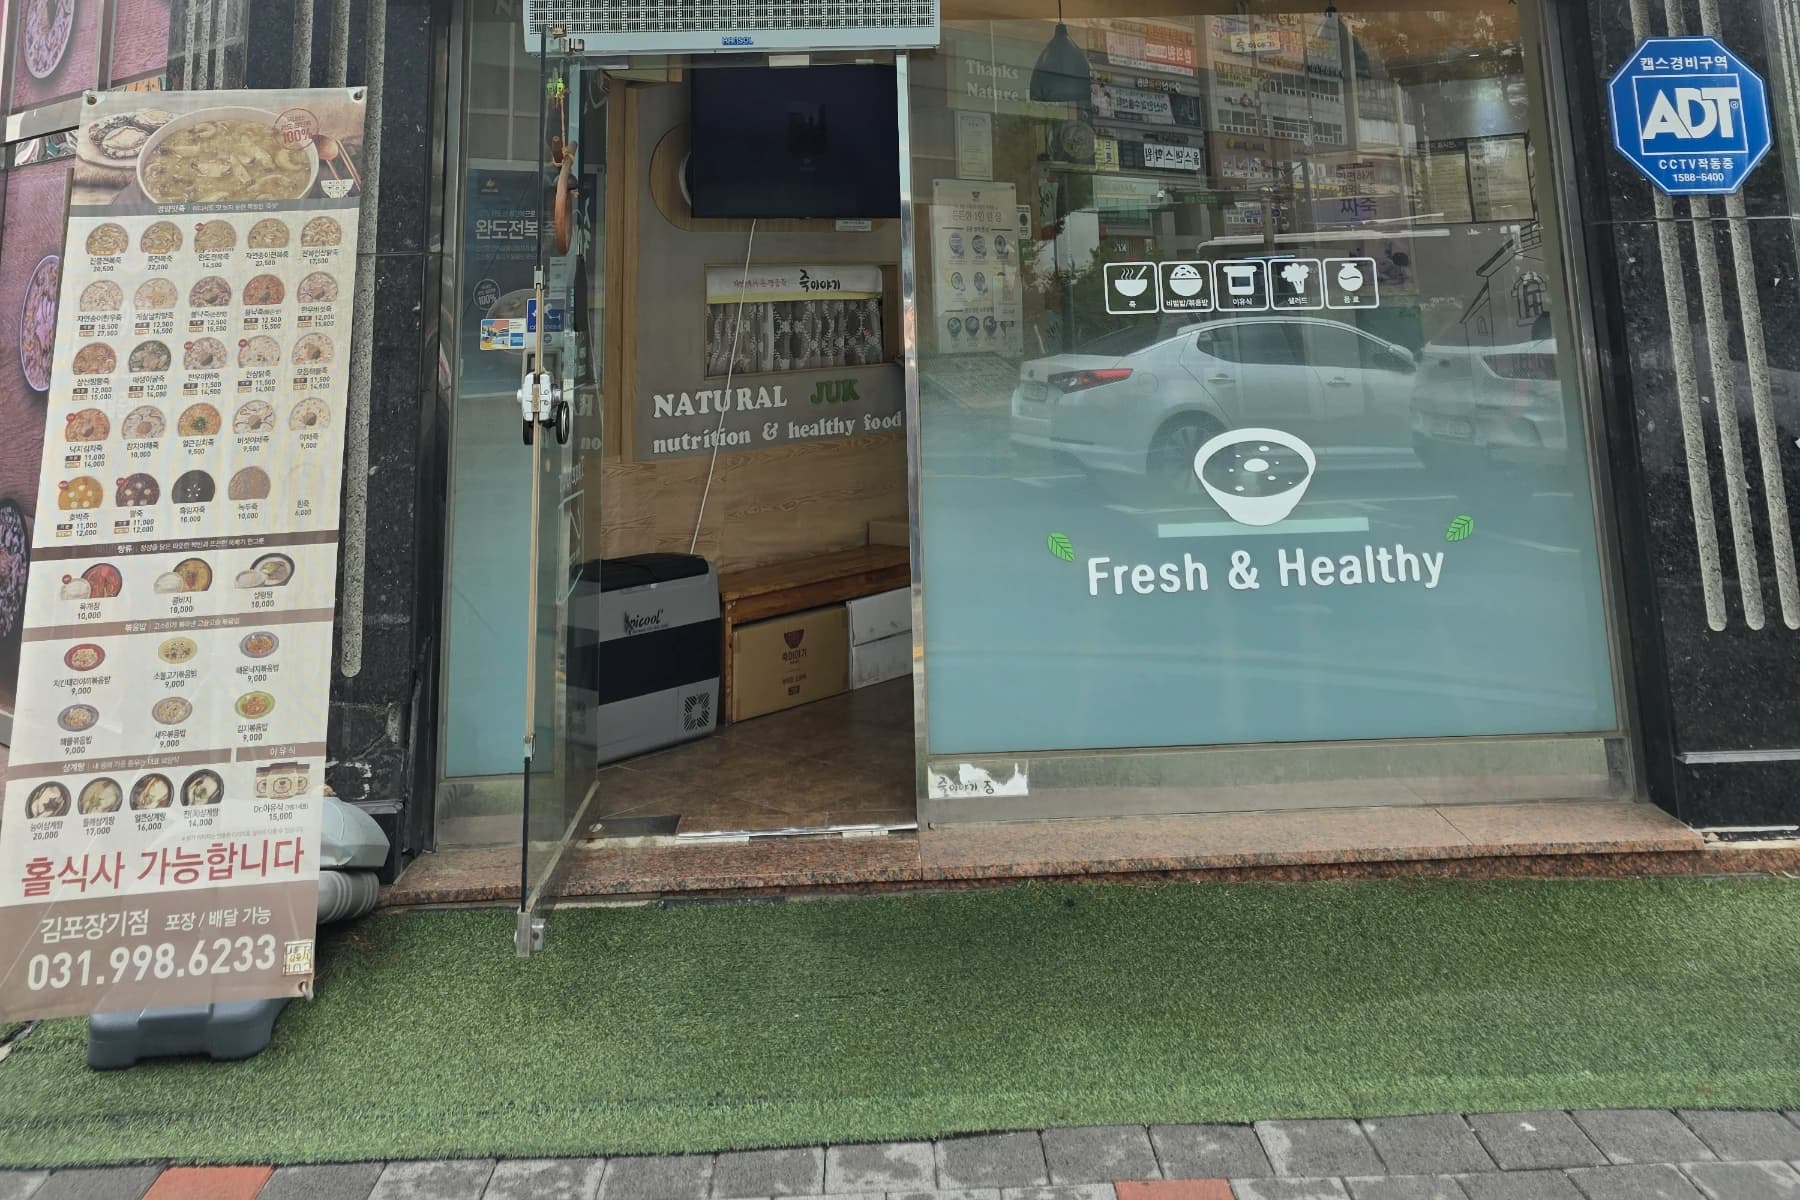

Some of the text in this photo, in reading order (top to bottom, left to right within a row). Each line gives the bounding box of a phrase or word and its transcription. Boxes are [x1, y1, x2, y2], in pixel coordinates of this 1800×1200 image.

[1640, 56, 1728, 71] 캡스경비구역
[1642, 87, 1741, 140] ADT
[1659, 158, 1734, 170] CCTV작동중
[653, 378, 860, 418] NATURAL JUK
[653, 411, 902, 454] nutrition & healthy food
[1088, 544, 1444, 596] Fresh & Healthy
[21, 836, 305, 898] 홀식사 가능합니다
[40, 908, 150, 944] 김포장기점
[164, 912, 197, 931] 포장
[208, 909, 238, 929] 배달
[241, 906, 272, 926] 가능
[27, 934, 277, 992] 031.998.6233
